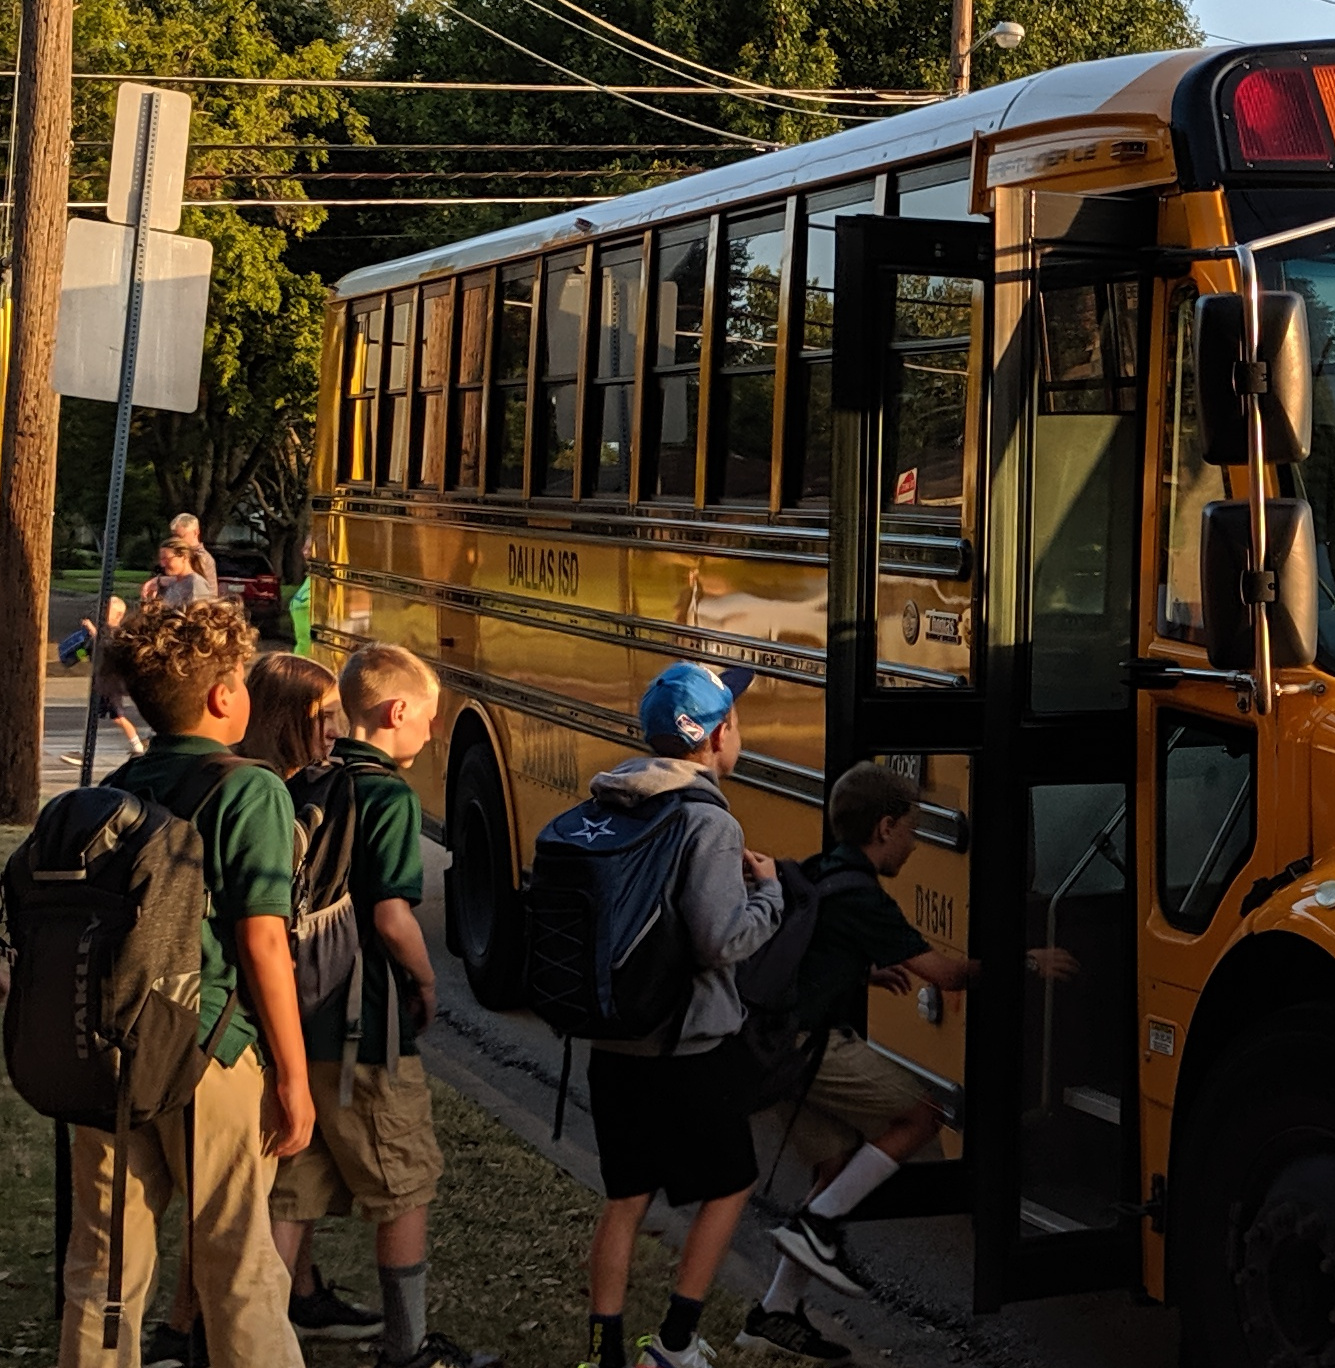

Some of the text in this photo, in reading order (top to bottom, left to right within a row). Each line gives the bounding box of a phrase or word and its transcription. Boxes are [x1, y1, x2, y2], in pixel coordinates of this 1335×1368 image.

[508, 543, 579, 597] DALLAS ISD
[915, 884, 953, 940] D1541
